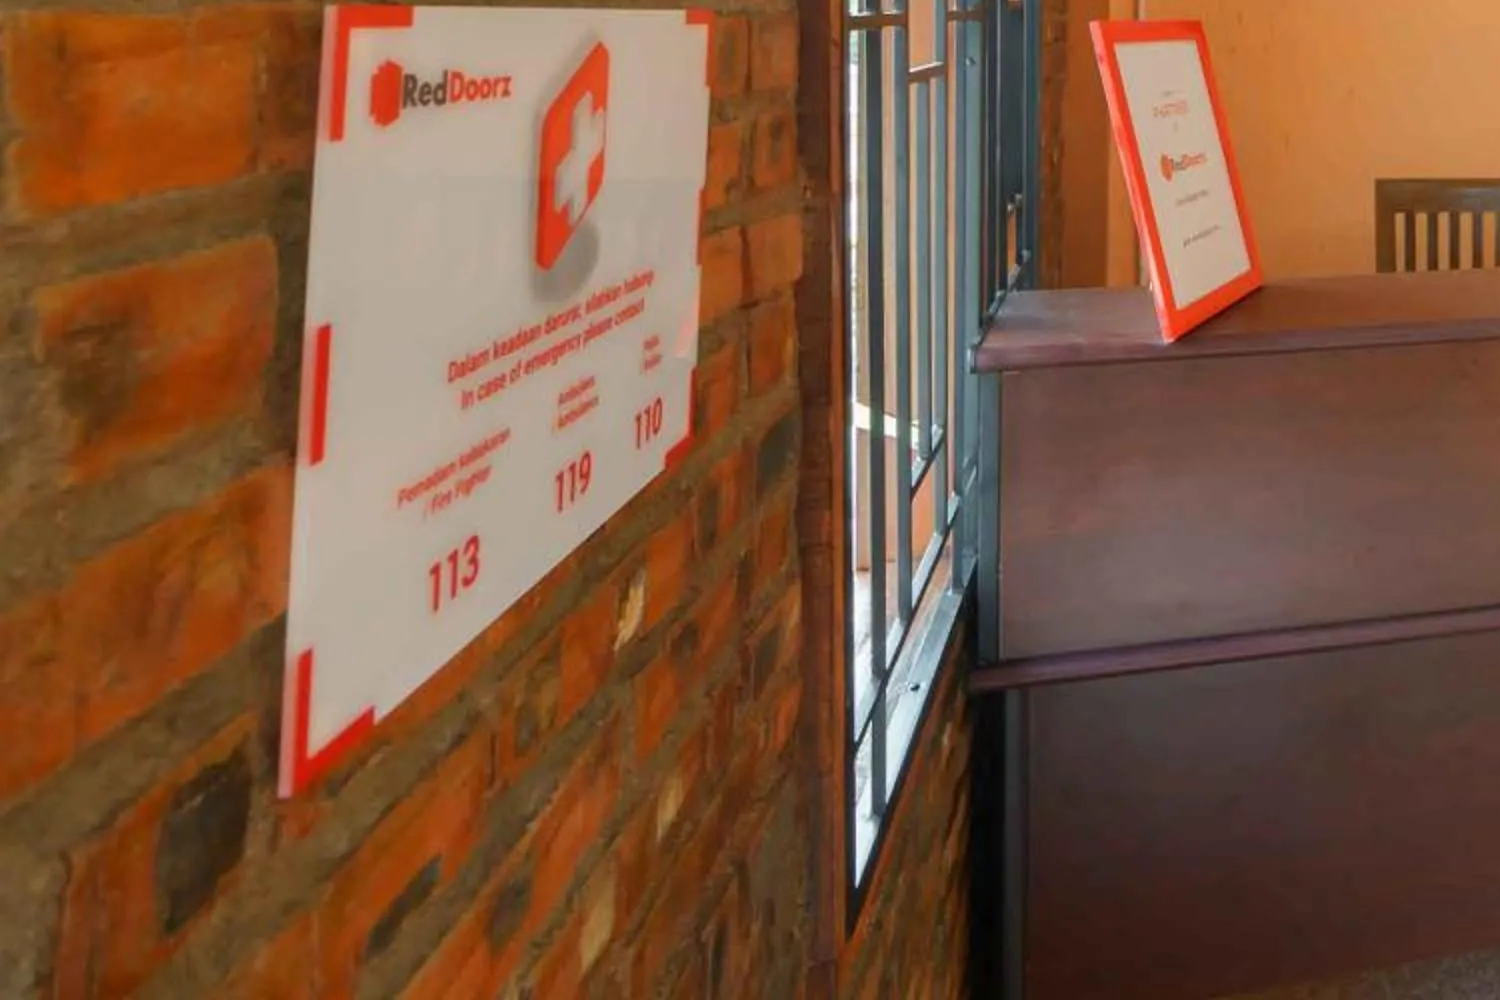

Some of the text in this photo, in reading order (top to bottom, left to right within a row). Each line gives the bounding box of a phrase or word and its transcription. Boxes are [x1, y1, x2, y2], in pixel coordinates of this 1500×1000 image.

[402, 69, 512, 109] RedDoorz
[509, 363, 523, 387] of
[634, 397, 663, 450] 110
[555, 451, 593, 514] 119
[429, 534, 482, 614] 113
